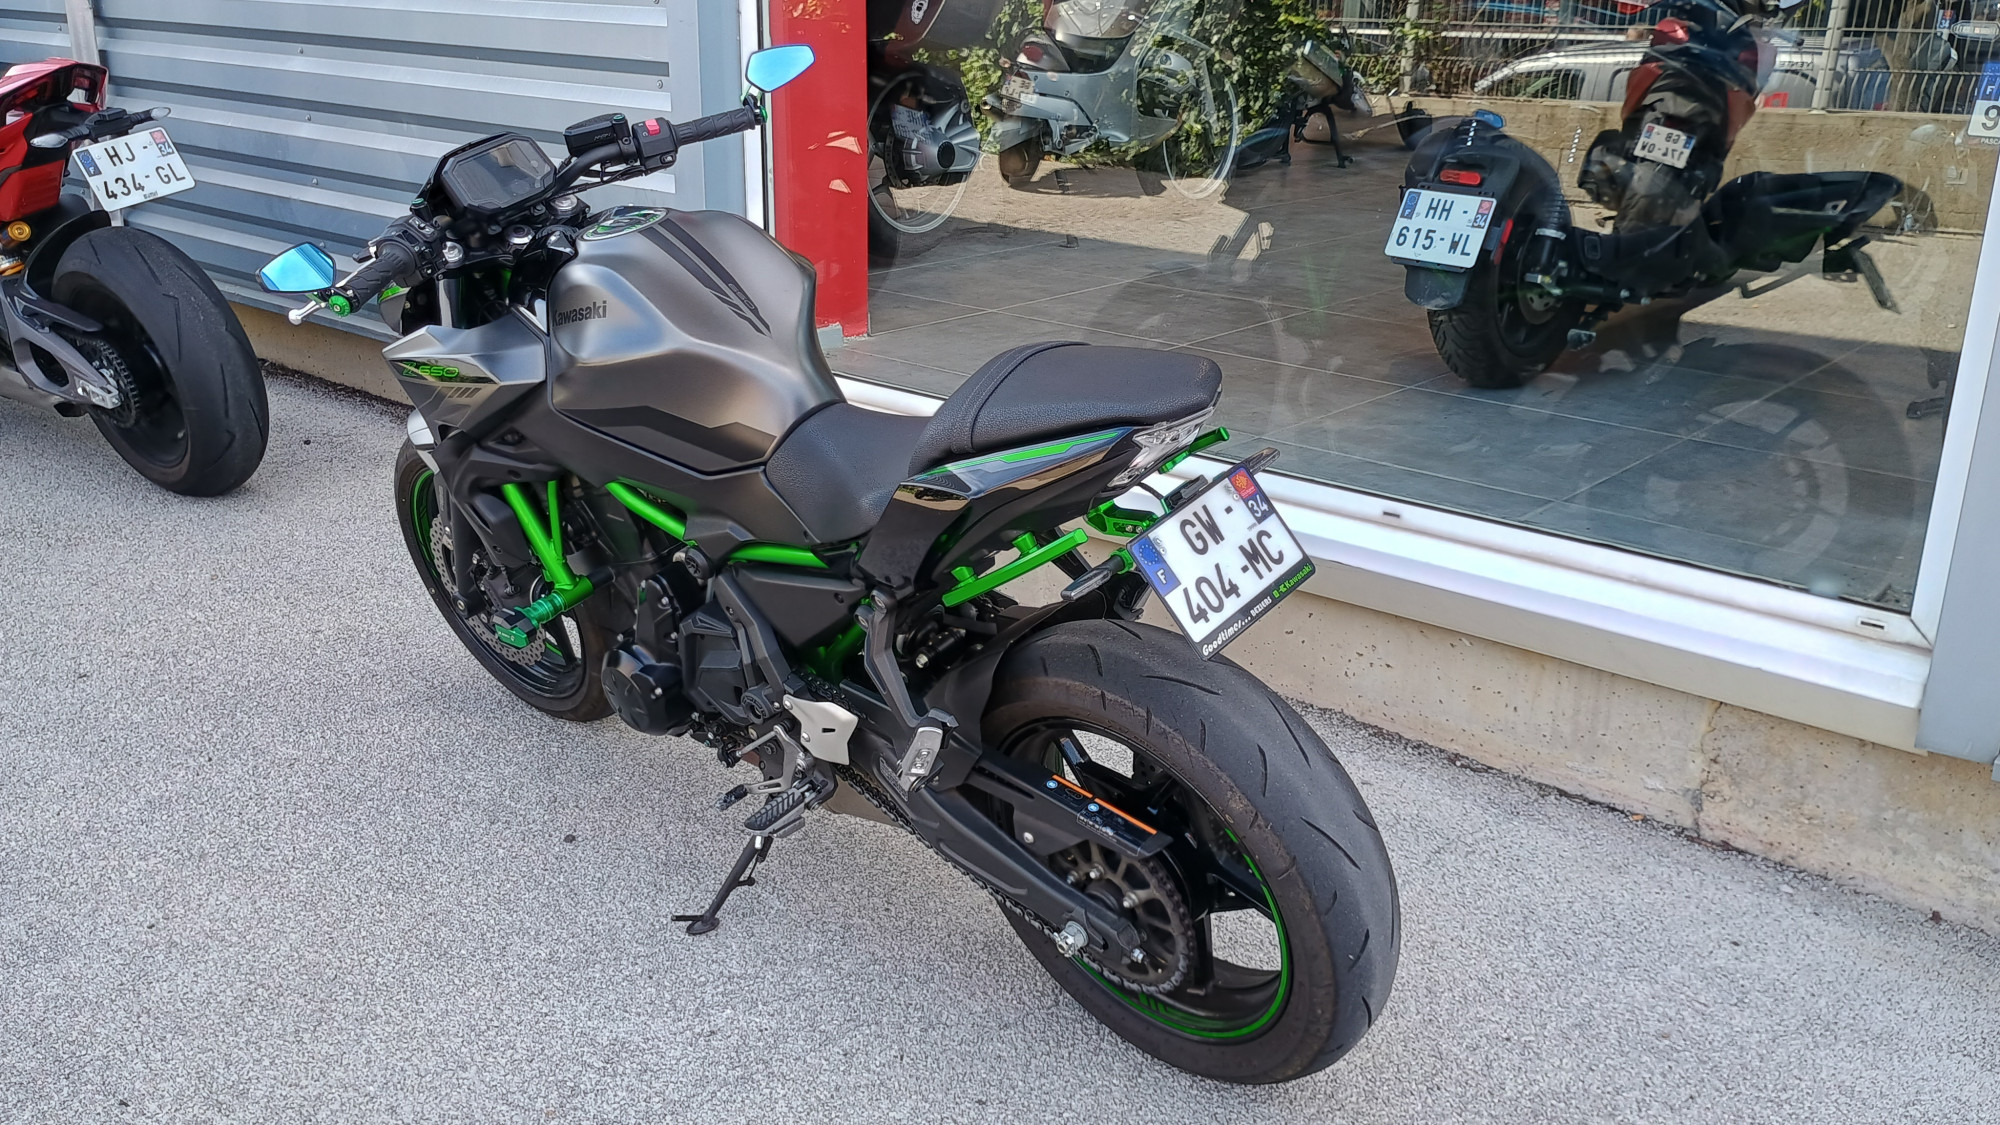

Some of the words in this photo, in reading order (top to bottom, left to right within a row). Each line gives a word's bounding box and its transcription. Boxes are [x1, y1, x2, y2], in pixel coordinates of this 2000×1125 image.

[158, 143, 173, 156] 34
[89, 166, 95, 174] F
[1404, 209, 1412, 217] F
[1473, 214, 1488, 227] 34
[552, 300, 607, 328] Kawasaki
[1247, 494, 1269, 518] 34
[1156, 569, 1167, 585] F
[1284, 563, 1313, 590] Kawasaki
